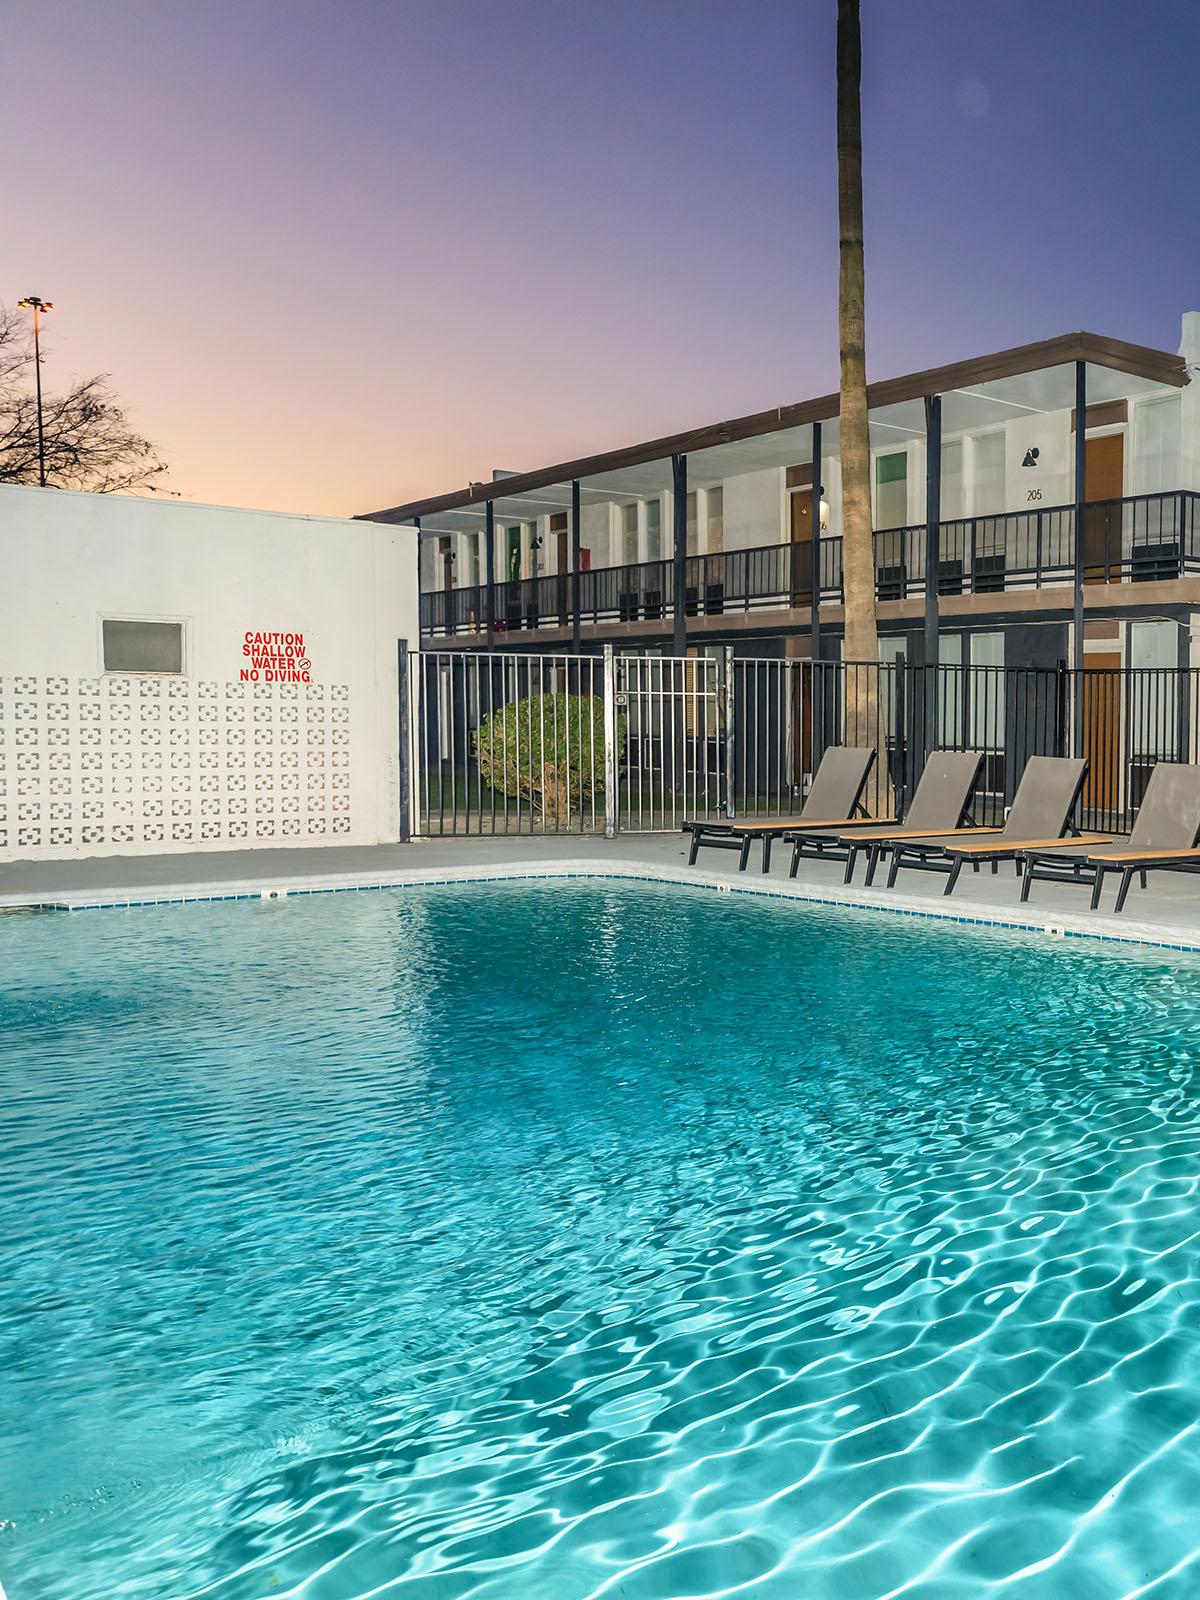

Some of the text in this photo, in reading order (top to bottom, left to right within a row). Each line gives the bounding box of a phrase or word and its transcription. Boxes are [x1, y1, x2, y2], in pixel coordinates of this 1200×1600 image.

[1027, 489, 1042, 501] 205
[244, 632, 303, 645] CAUTION
[242, 644, 306, 657] SHALLOW
[251, 657, 296, 669] WATER
[240, 669, 311, 682] NO DIVING
